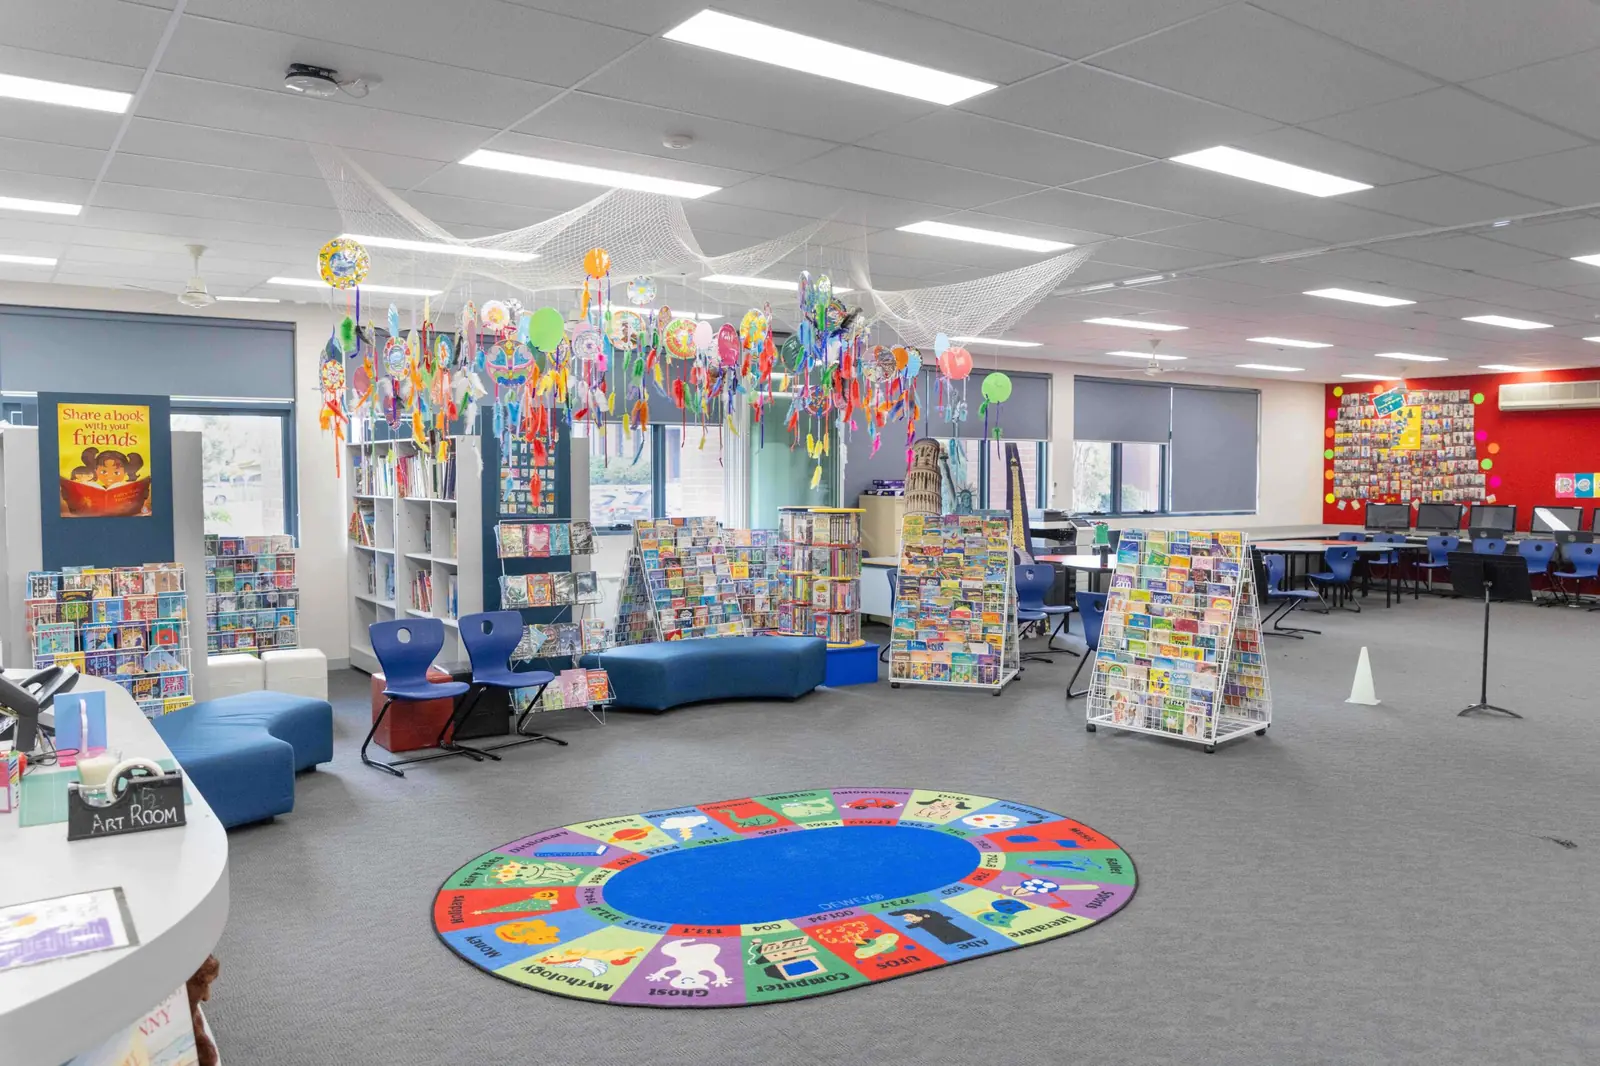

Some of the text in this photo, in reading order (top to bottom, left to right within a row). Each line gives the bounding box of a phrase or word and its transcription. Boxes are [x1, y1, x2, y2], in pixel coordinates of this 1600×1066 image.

[63, 408, 144, 422] Share a book
[84, 422, 131, 432] with your
[73, 428, 138, 447] friends
[766, 792, 816, 802] Whales
[938, 794, 970, 802] Dogs
[645, 807, 697, 820] Weather
[585, 817, 635, 830] Planets
[509, 831, 569, 853] Dictionary
[459, 855, 505, 888] Fairy Tales
[1084, 889, 1115, 910] Sports
[450, 895, 465, 925] Holidays
[1007, 914, 1077, 939] Literature
[464, 934, 503, 959] Money
[957, 937, 990, 950] Abe
[875, 955, 922, 970] UFOs
[521, 963, 615, 993] Mythology
[755, 972, 850, 993] Computer
[648, 987, 709, 998] Ghost
